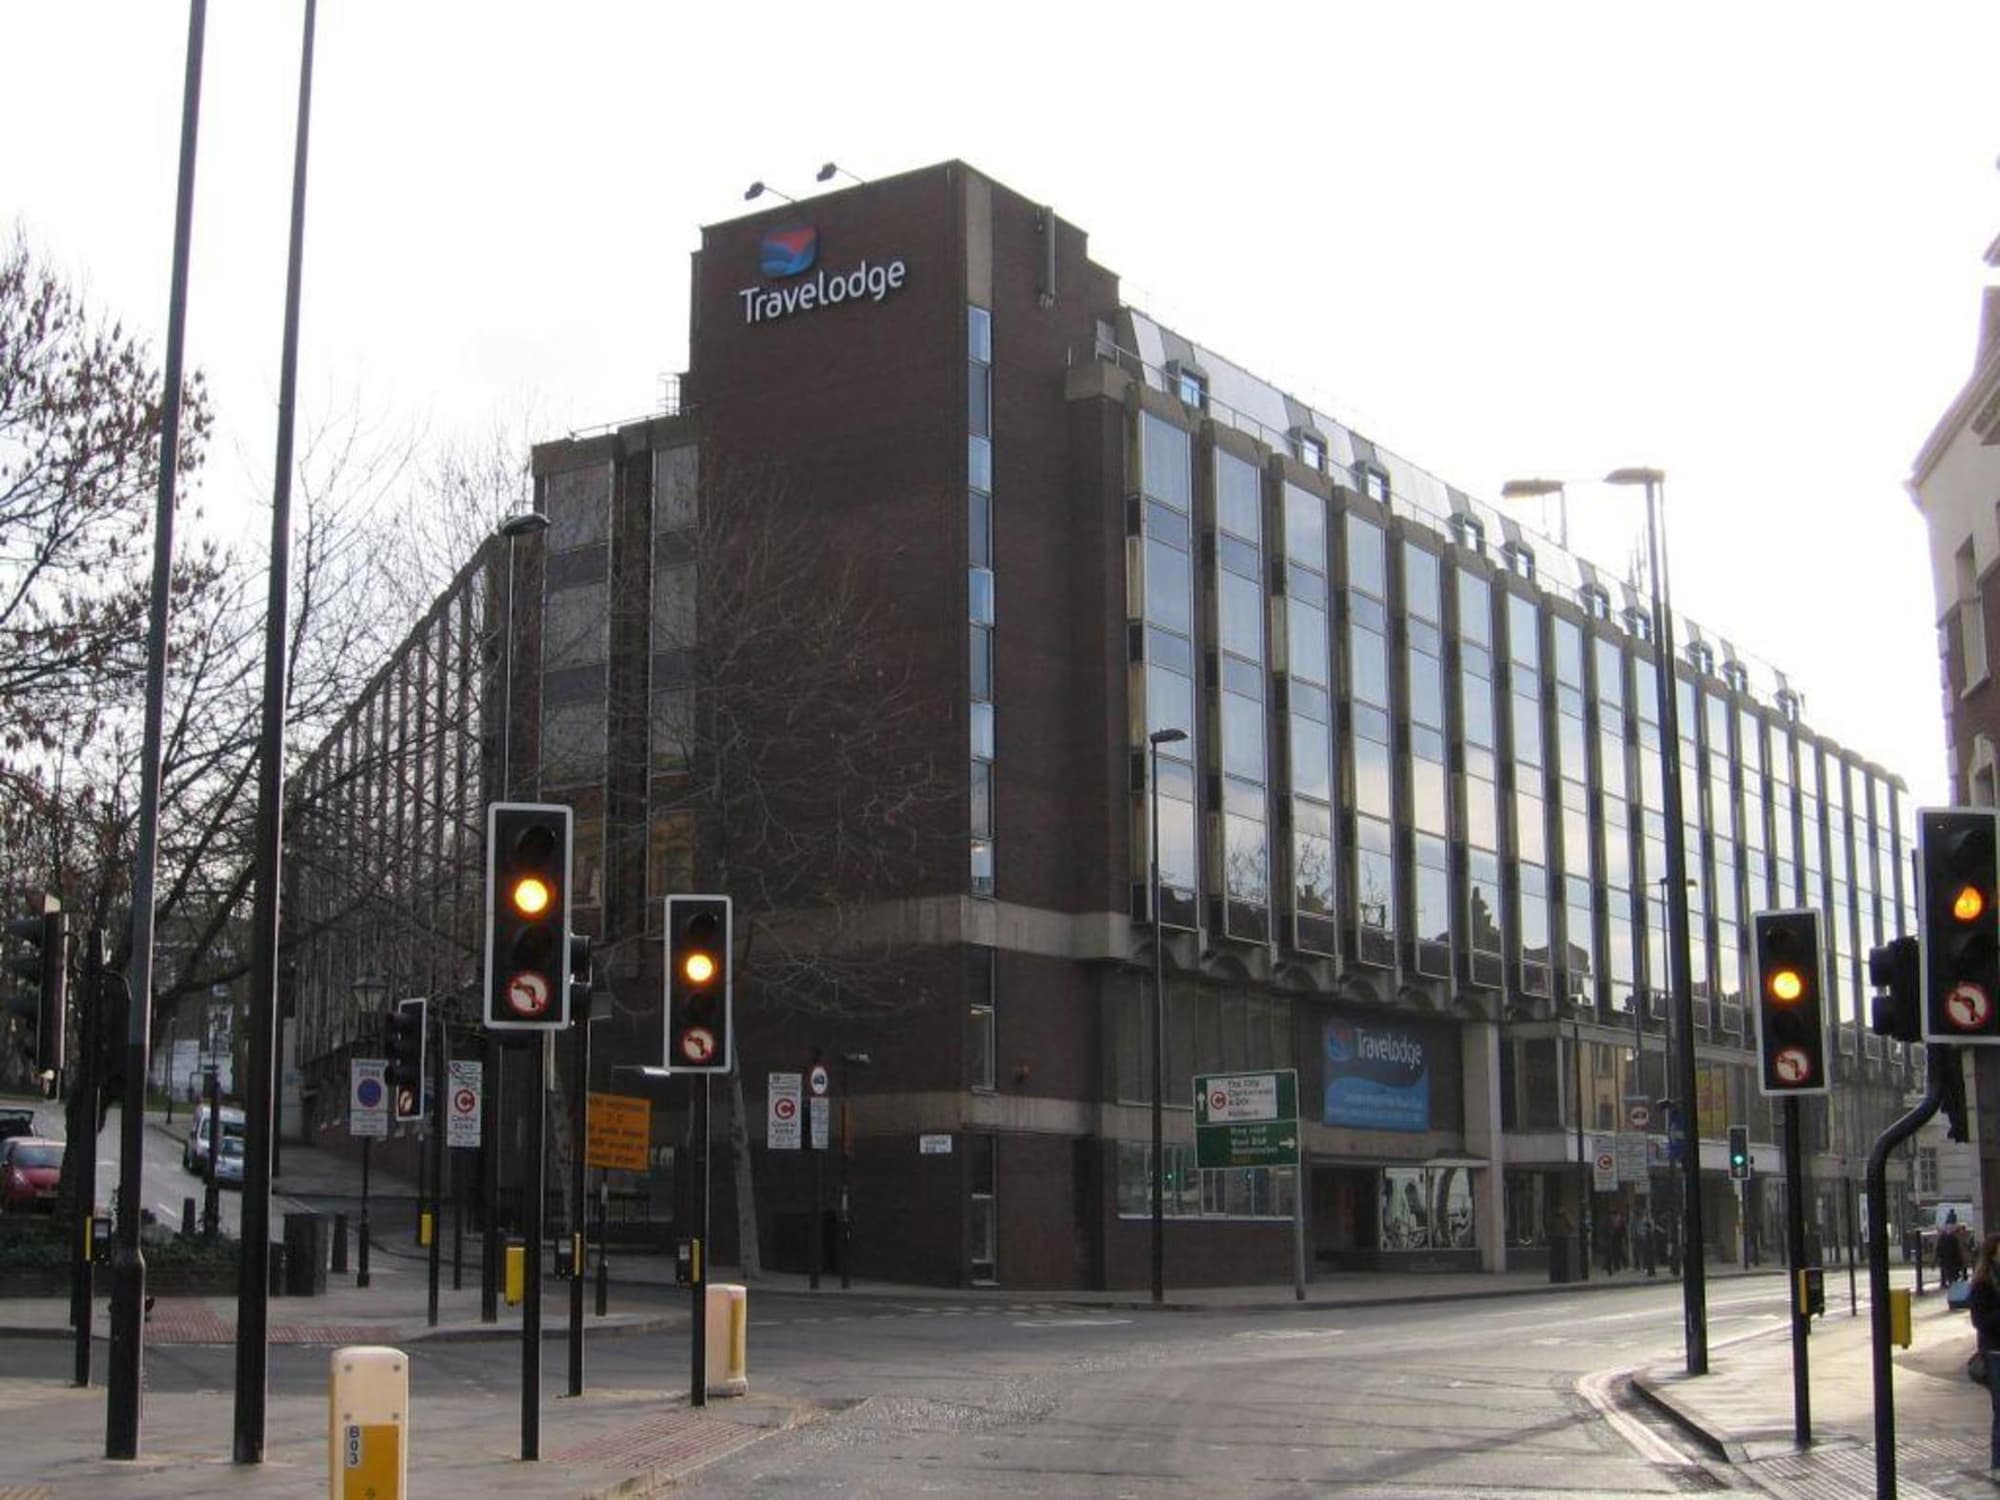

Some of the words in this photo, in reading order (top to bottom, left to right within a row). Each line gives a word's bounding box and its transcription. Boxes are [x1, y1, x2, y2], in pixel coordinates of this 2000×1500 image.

[739, 259, 906, 324] Travelodge
[1354, 1027, 1422, 1071] Travelodge
[350, 1425, 360, 1466] B03
